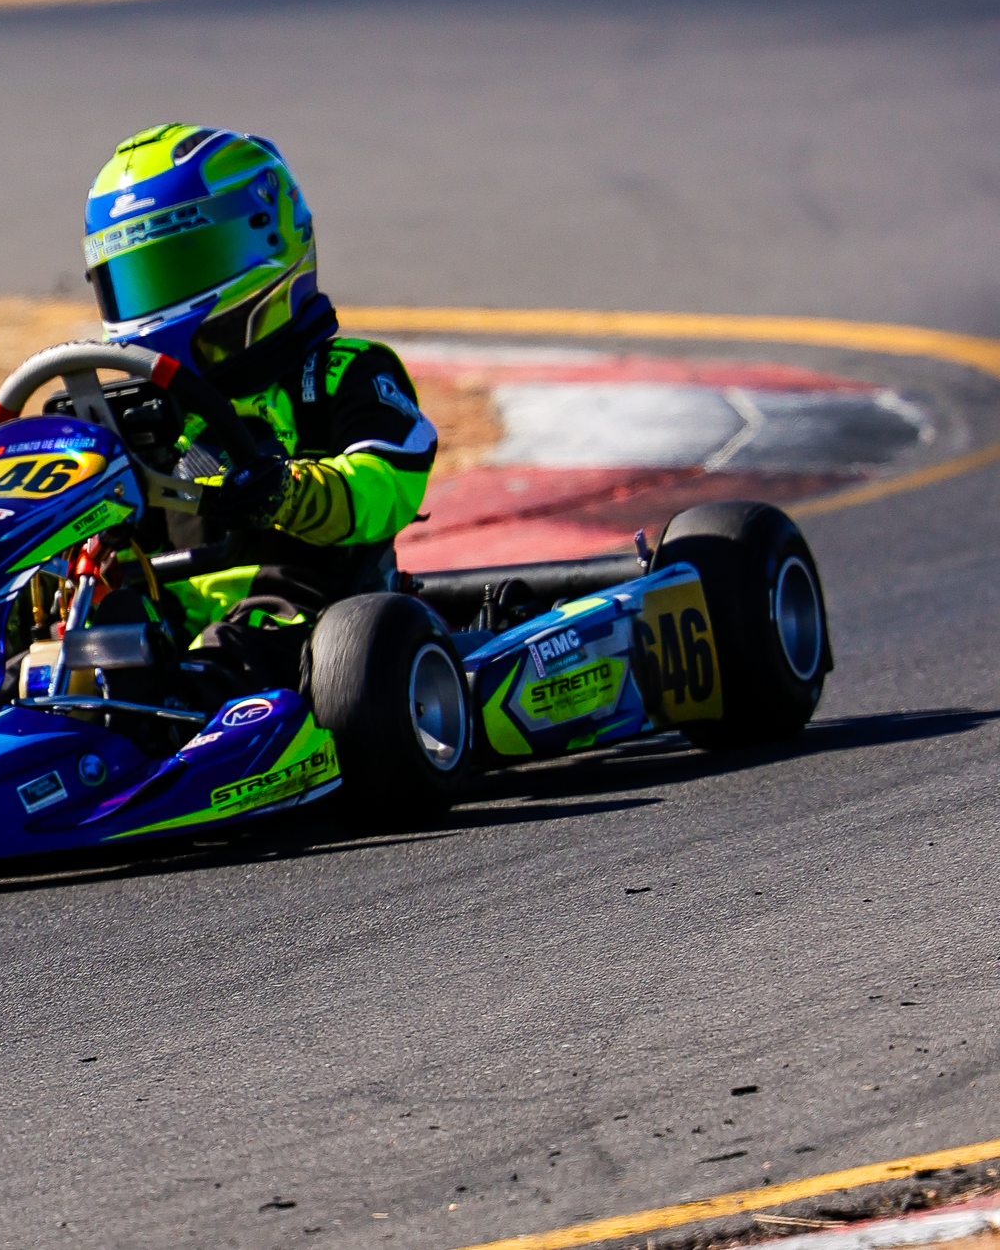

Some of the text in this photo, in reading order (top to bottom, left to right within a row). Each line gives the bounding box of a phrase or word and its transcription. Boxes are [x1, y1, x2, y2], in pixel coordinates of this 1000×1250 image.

[72, 504, 107, 532] STRETTO
[539, 628, 580, 662] RMC
[633, 608, 713, 714] 646
[532, 664, 610, 702] STRETTO
[213, 753, 324, 803] STRETTO
